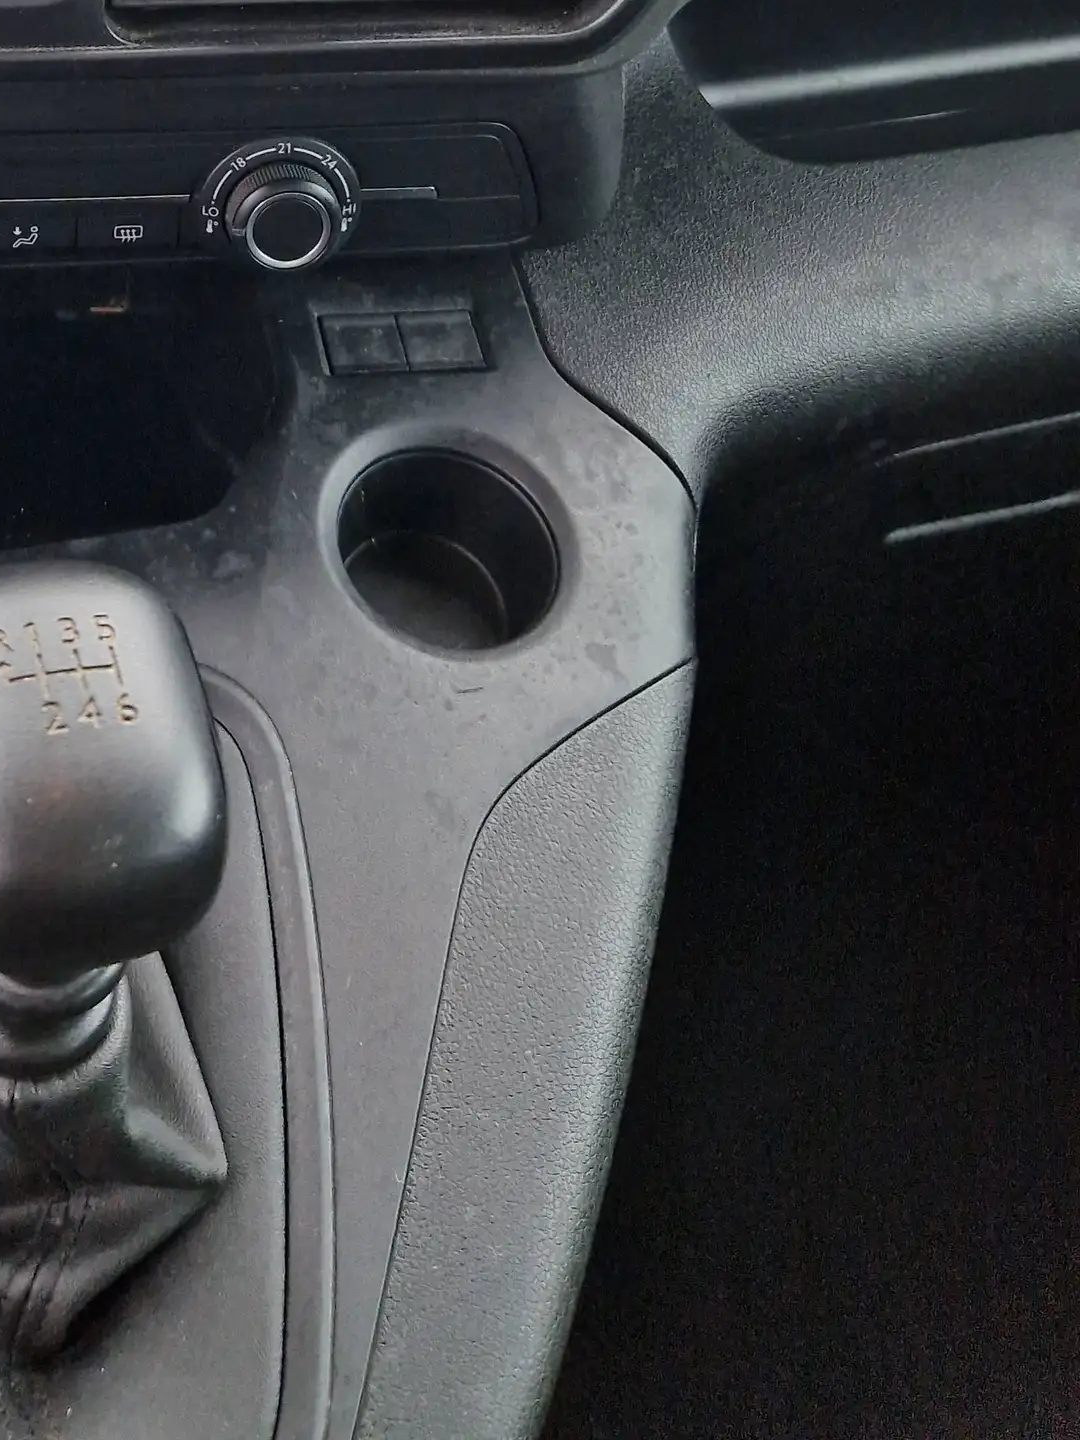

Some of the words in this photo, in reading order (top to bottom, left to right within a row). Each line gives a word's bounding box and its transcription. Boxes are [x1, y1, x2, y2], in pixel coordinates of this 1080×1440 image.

[277, 142, 292, 155] 21
[230, 156, 247, 172] 18
[320, 154, 338, 170] 24
[201, 205, 220, 217] LO
[56, 616, 80, 644] 3
[92, 613, 117, 642] 5
[41, 700, 70, 735] 2
[77, 695, 103, 728] 4
